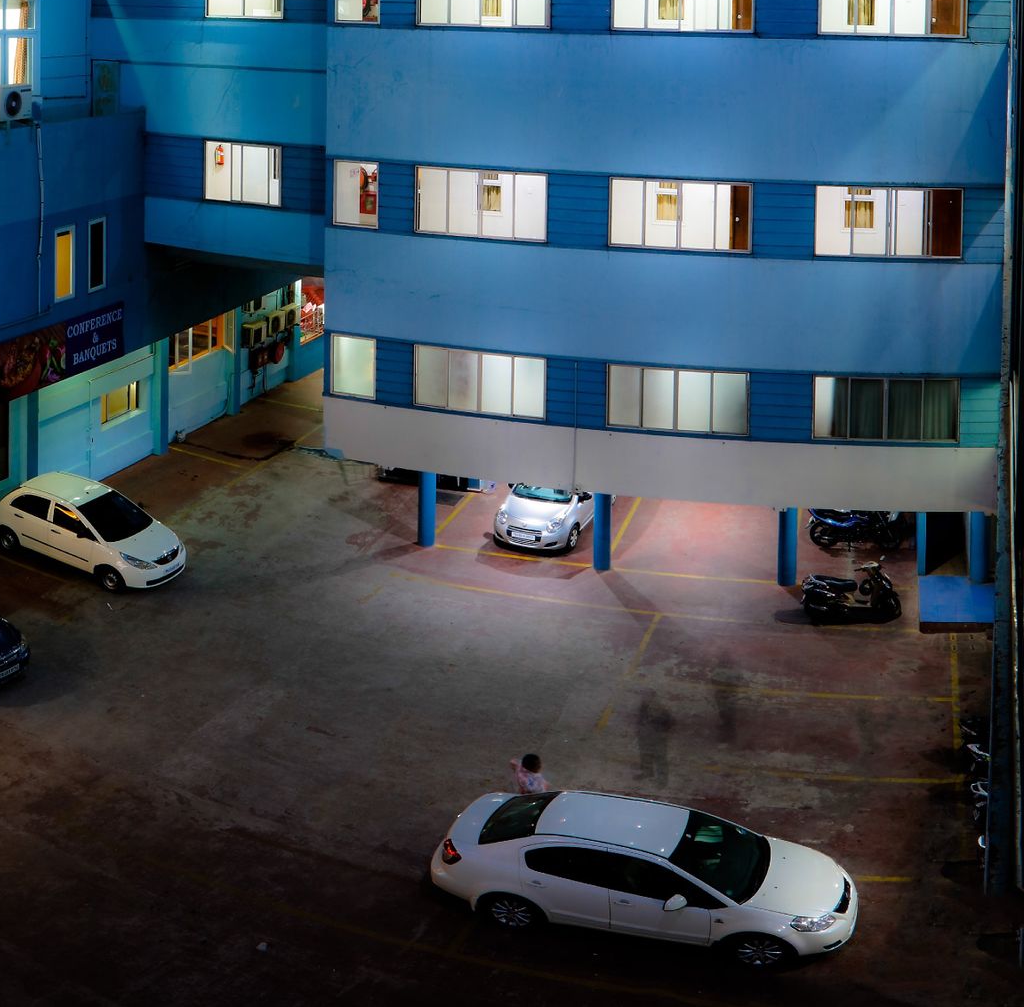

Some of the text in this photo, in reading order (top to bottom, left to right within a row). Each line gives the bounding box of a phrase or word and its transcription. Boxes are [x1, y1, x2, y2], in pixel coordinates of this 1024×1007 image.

[67, 308, 123, 338] CONFERENCE
[73, 338, 117, 365] BANQUETS
[92, 332, 99, 344] &
